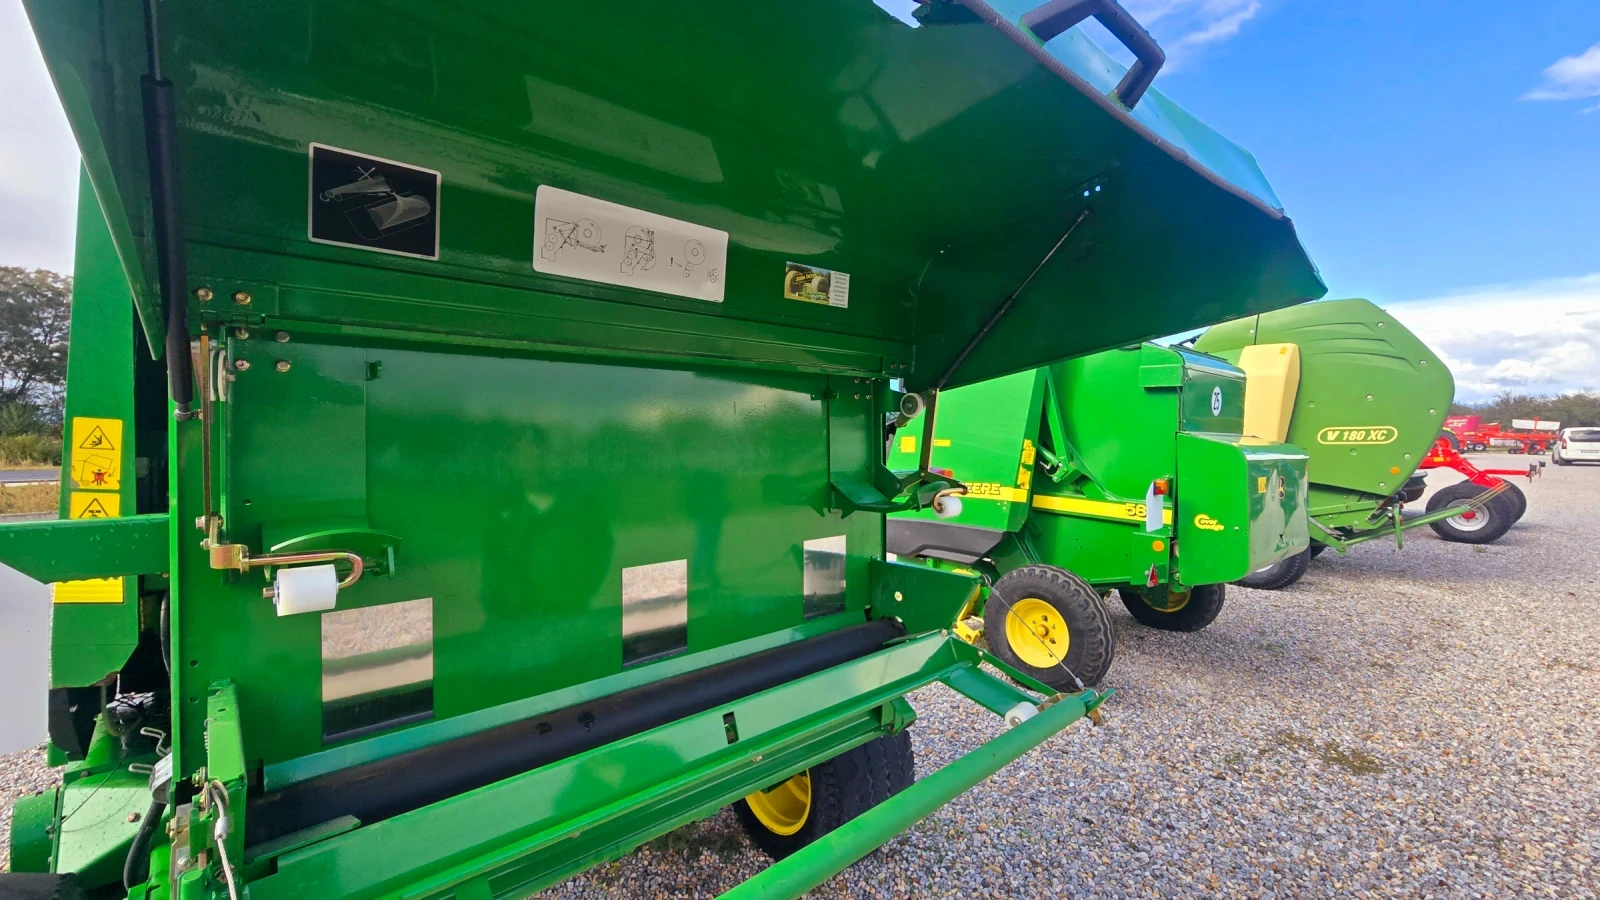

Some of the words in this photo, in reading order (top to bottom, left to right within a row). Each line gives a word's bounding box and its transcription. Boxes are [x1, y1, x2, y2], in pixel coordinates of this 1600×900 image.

[1214, 391, 1220, 411] 25
[1342, 430, 1366, 441] 180
[1367, 430, 1388, 441] XC
[965, 482, 1001, 495] EERE
[1125, 503, 1147, 517] 58
